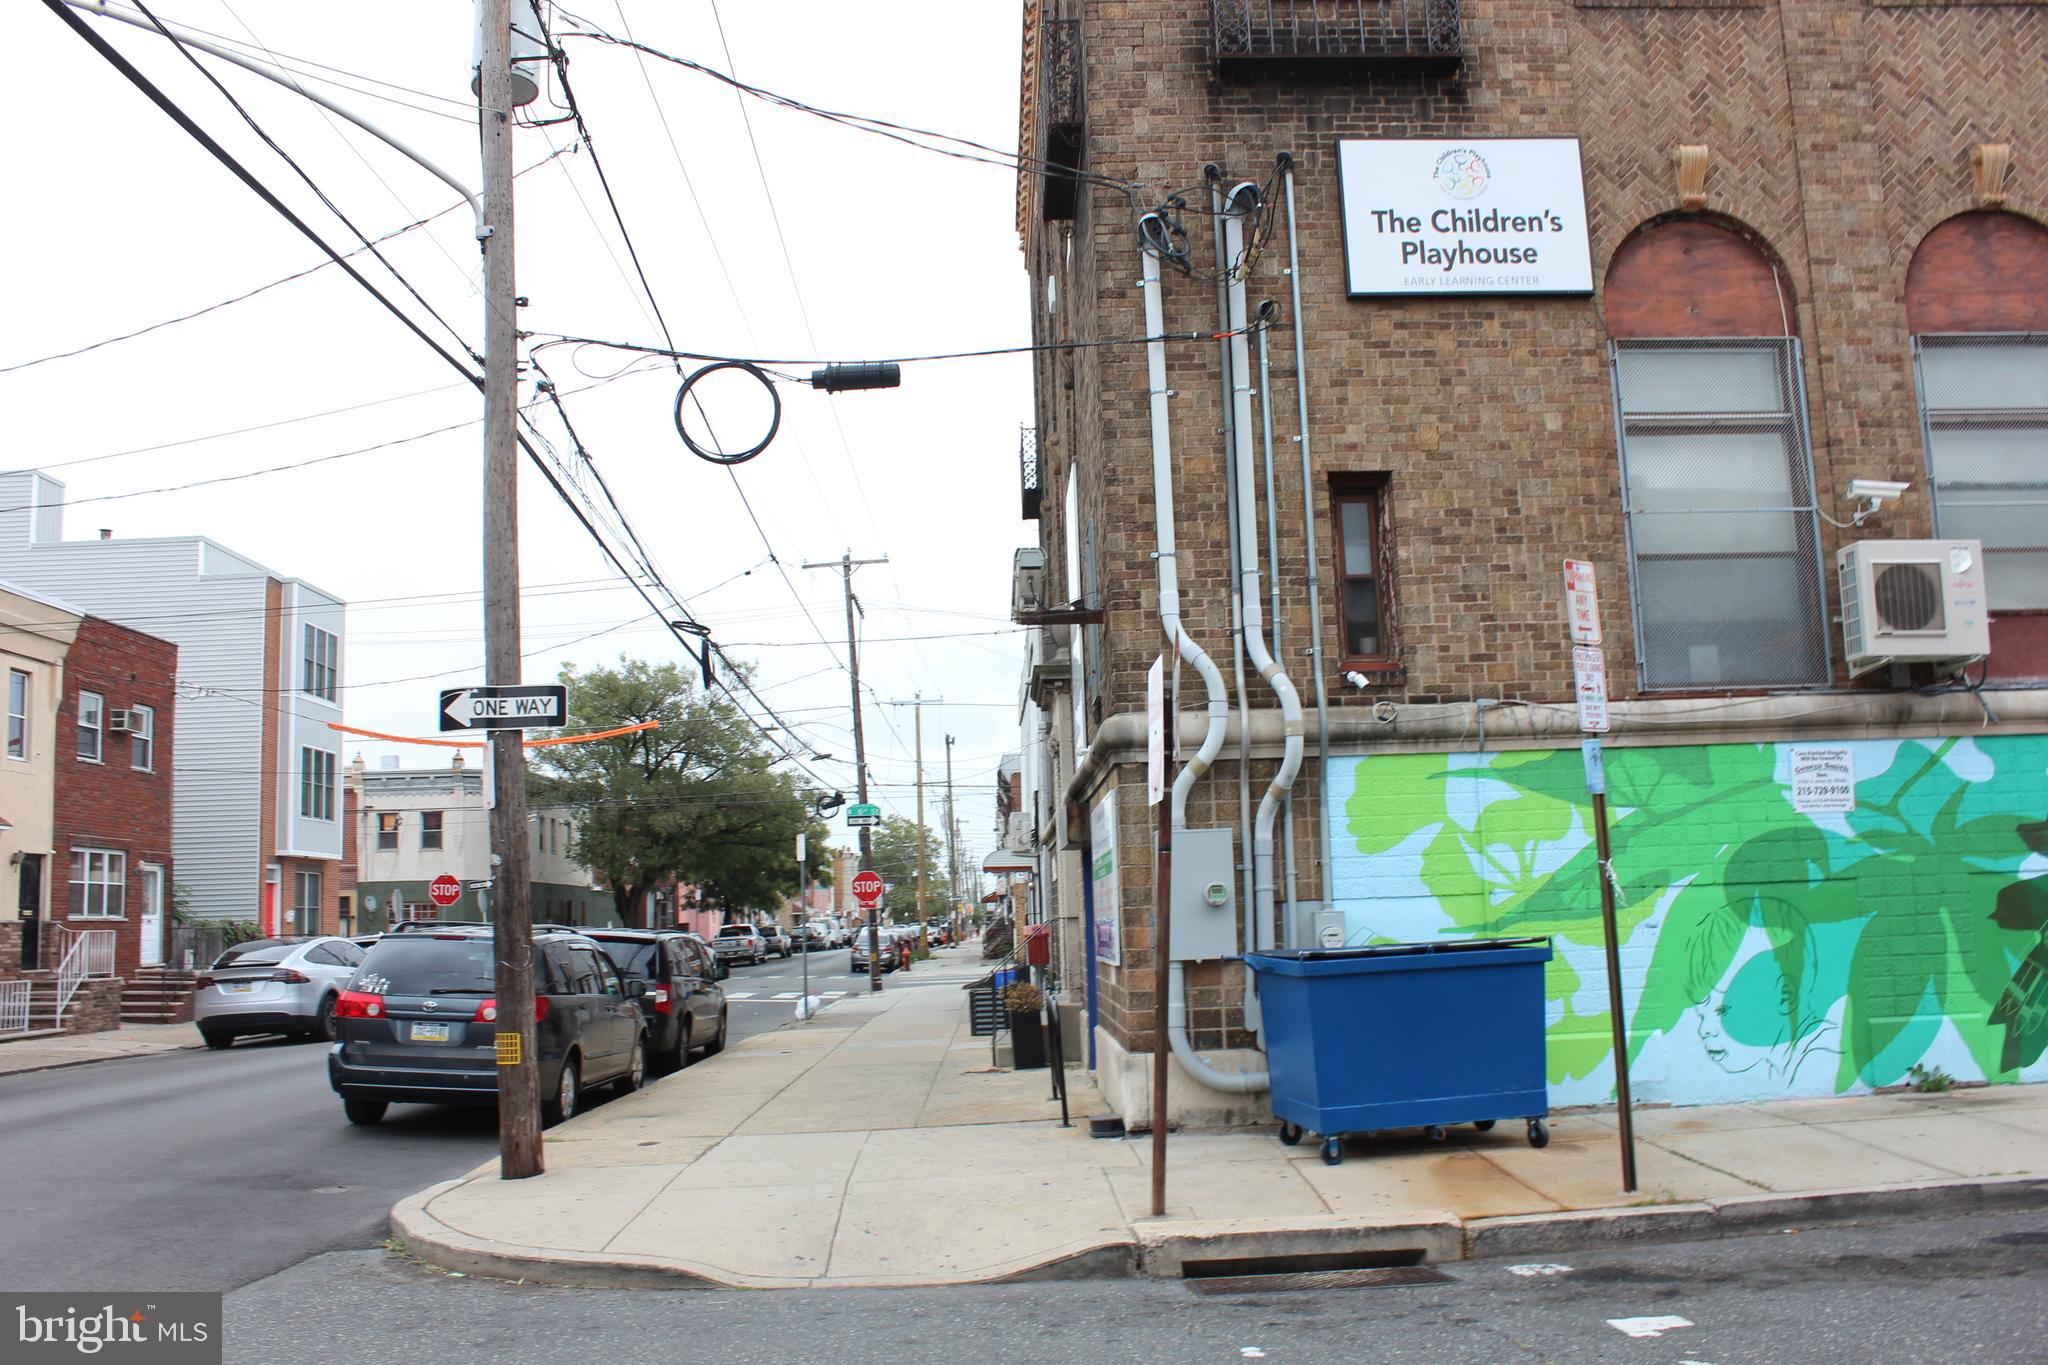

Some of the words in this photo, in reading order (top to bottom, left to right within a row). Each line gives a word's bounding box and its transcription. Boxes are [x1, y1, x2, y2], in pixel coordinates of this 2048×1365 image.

[1469, 149, 1491, 179] Playhouse
[1371, 209, 1422, 233] The
[1431, 208, 1563, 233] Children's
[1401, 240, 1538, 272] Playhouse
[1404, 276, 1435, 286] EARLY
[1439, 276, 1494, 286] LEARNING
[1497, 276, 1540, 286] CENTER
[474, 700, 508, 716] ONE
[516, 698, 551, 715] WAY
[432, 884, 460, 896] STOP
[853, 881, 881, 893] STOP
